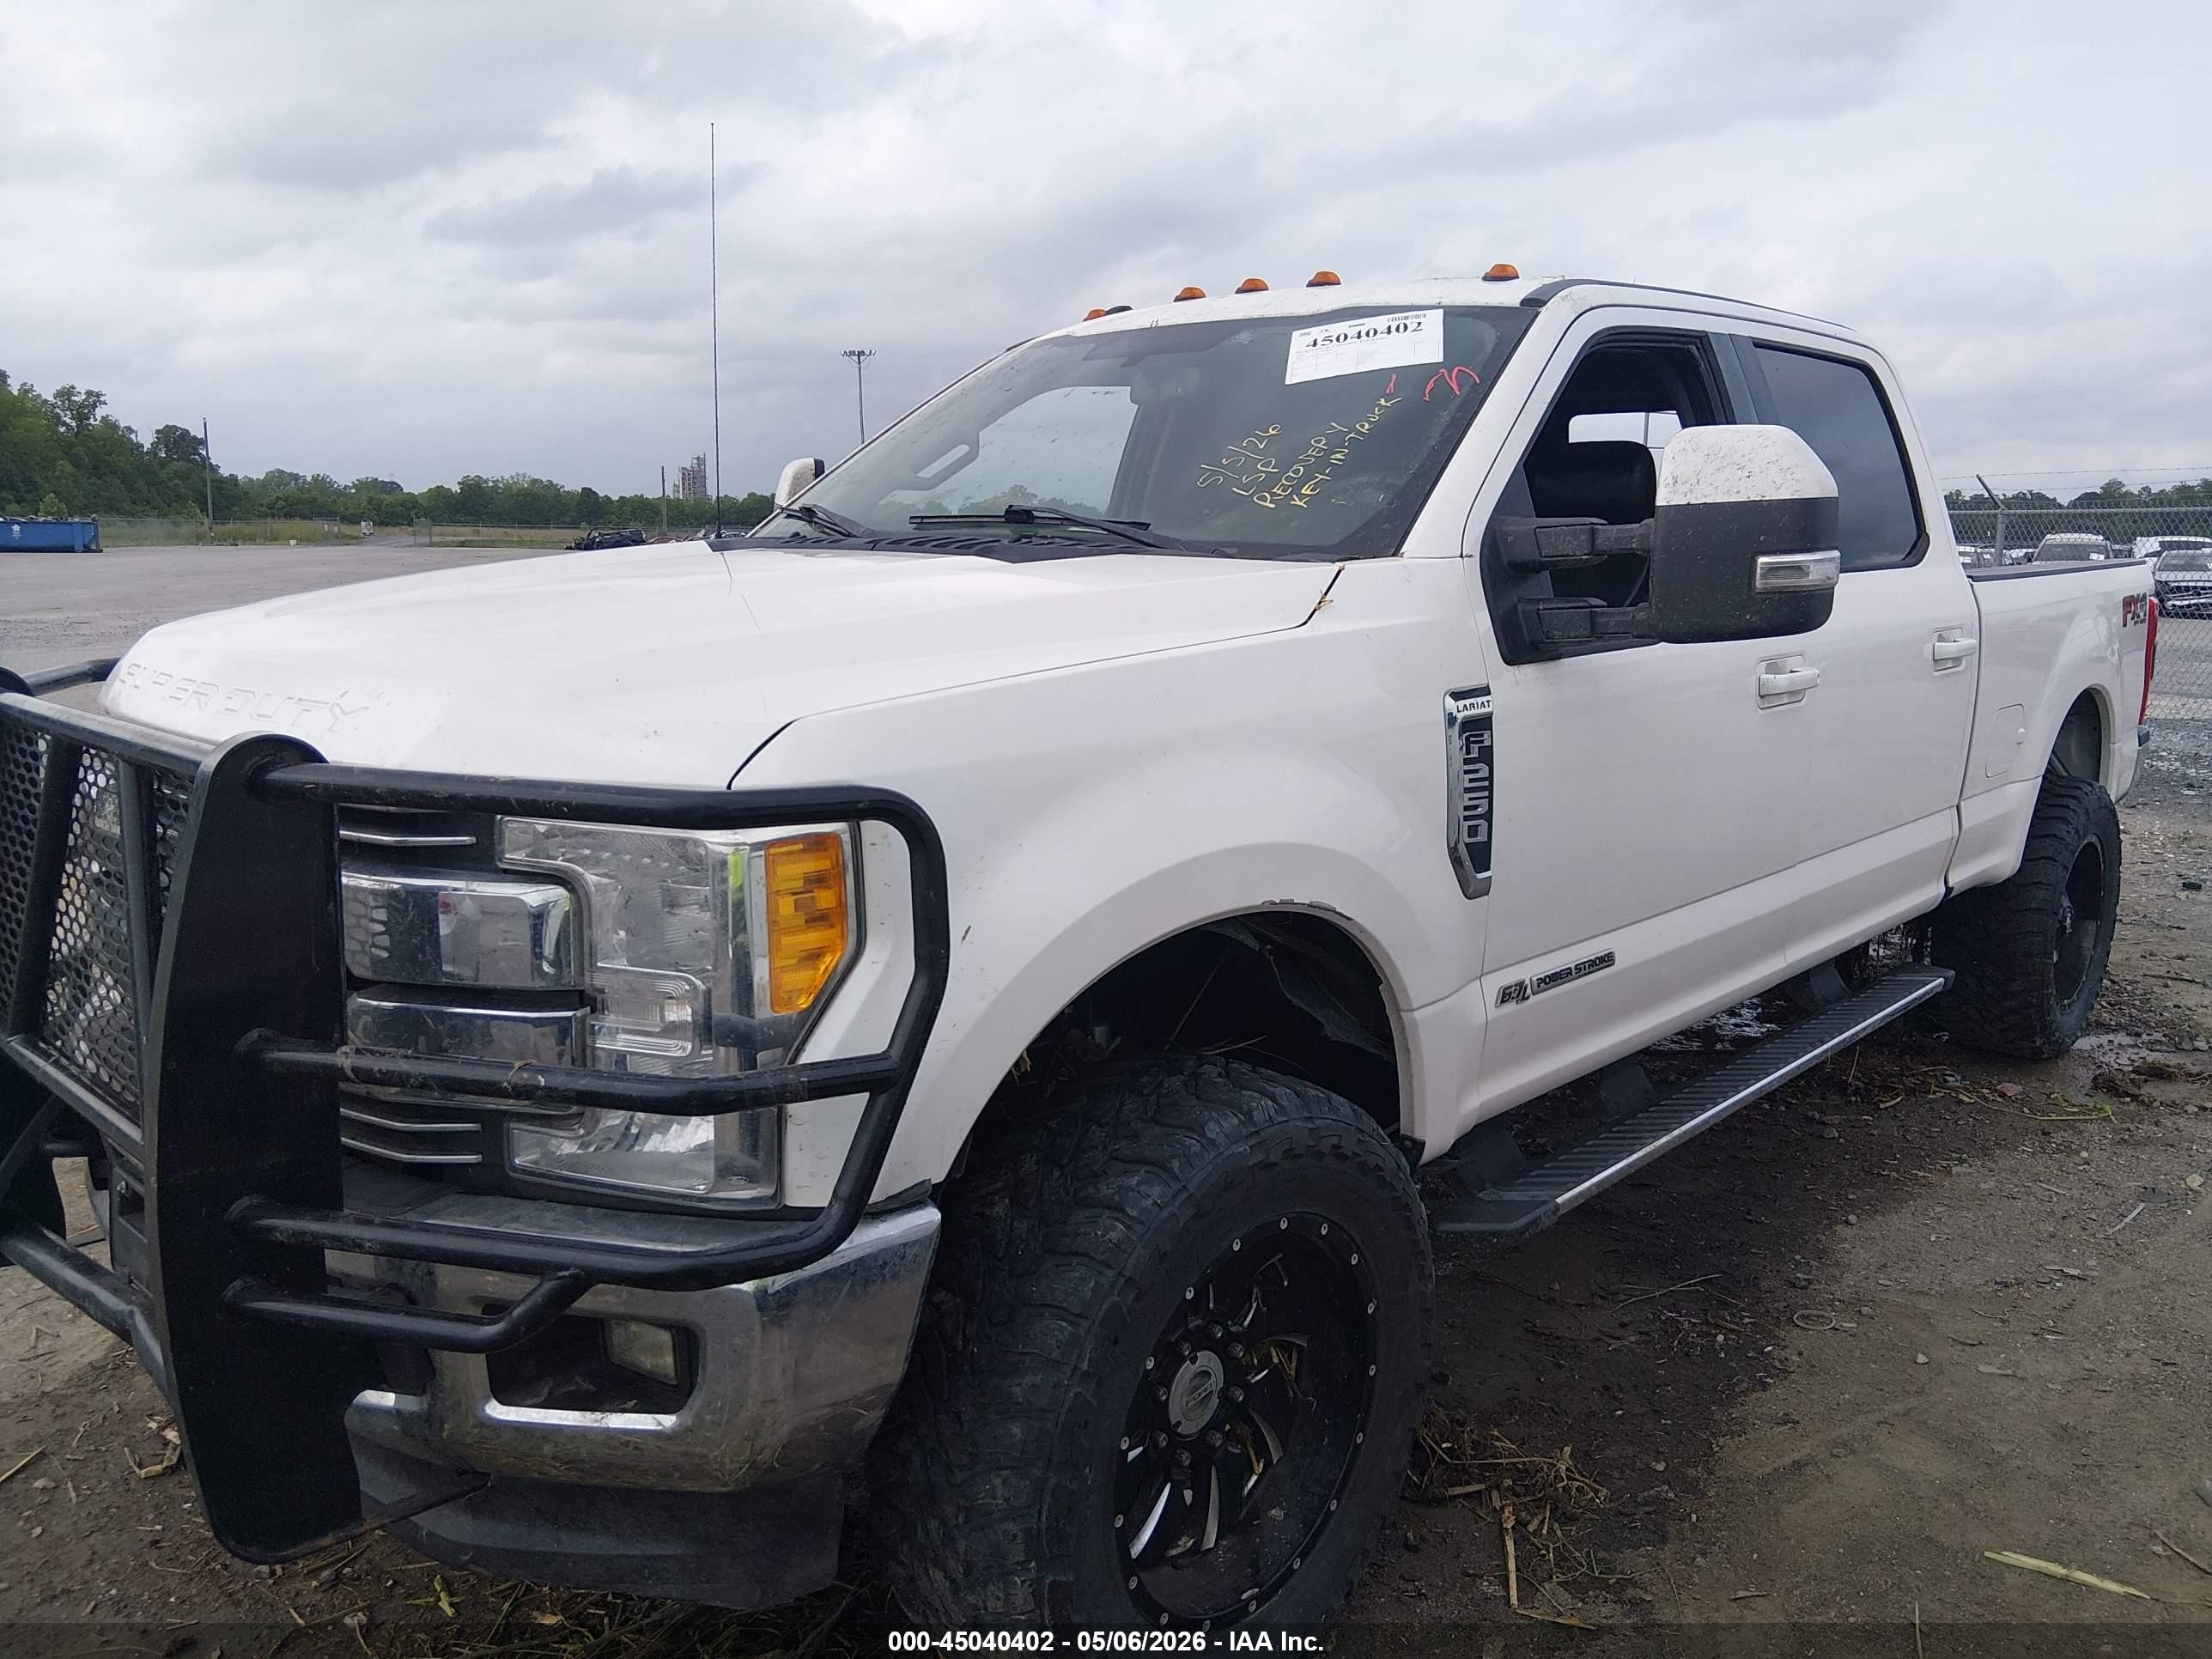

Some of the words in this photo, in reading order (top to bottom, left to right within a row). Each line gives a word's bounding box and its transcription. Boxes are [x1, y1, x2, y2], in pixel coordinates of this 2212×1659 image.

[1304, 320, 1424, 348] 45040402
[1253, 422, 1349, 508] RECOVERY
[222, 688, 385, 732] DUTY
[1456, 699, 1492, 713] LARIAT
[1535, 966, 1573, 988] POWER
[1574, 951, 1615, 975] STROKE
